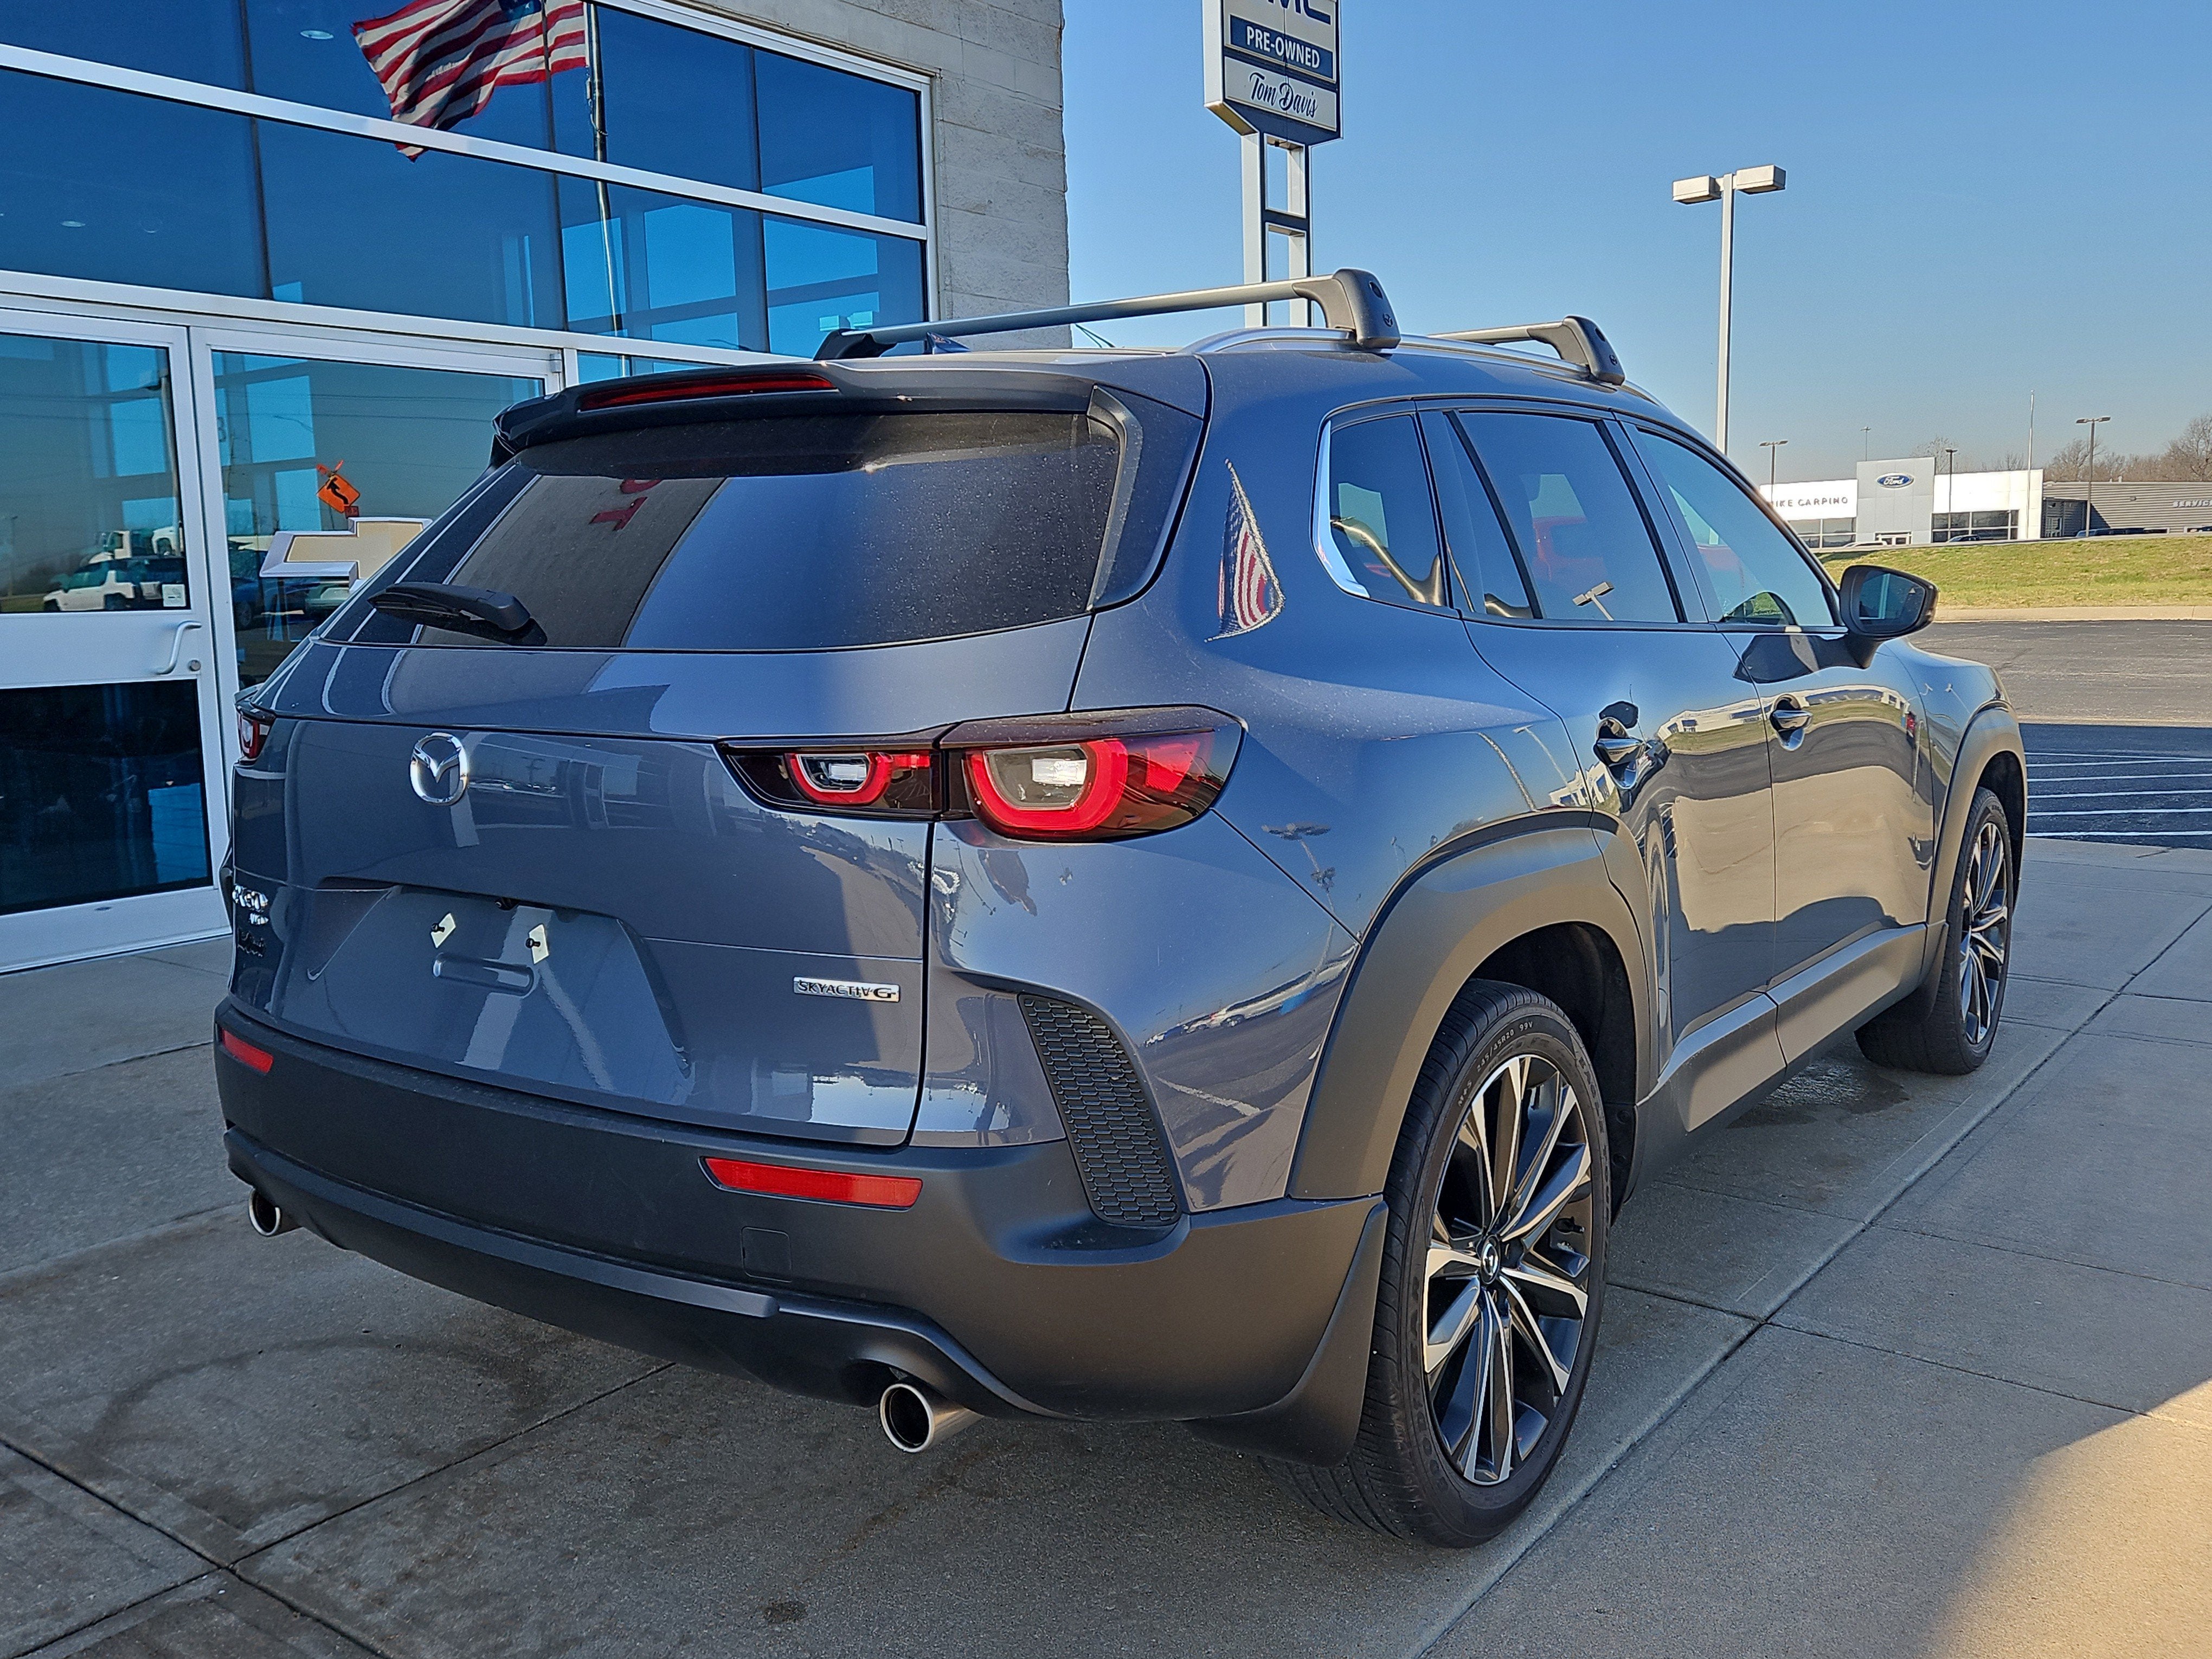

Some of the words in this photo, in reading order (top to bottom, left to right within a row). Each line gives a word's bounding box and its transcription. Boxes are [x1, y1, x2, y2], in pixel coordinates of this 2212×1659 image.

[1246, 25, 1320, 69] PRE-OWNED
[1249, 72, 1278, 106] Tom
[1279, 82, 1318, 118] Davis
[1883, 476, 1905, 485] Ford
[1798, 496, 1848, 506] CARPINO
[1519, 1021, 1533, 1032] 99V
